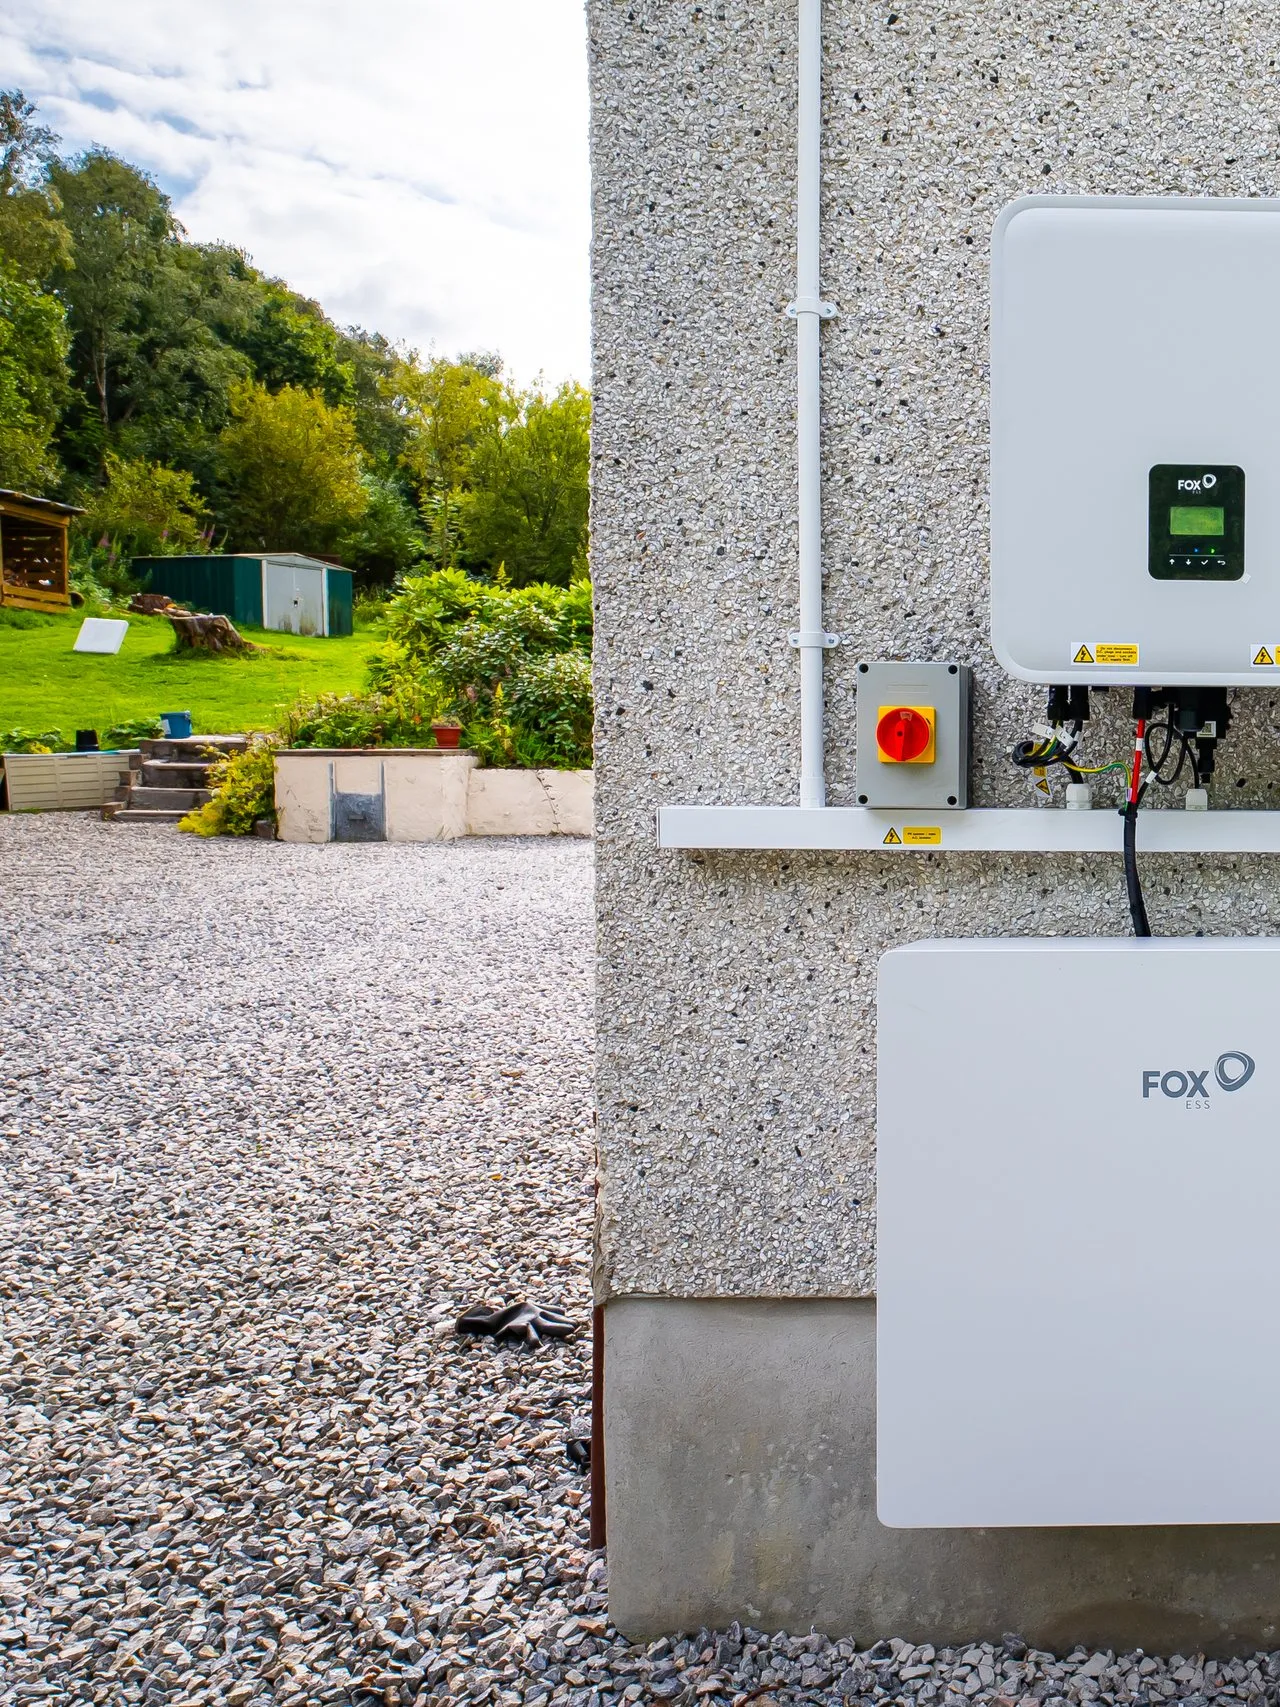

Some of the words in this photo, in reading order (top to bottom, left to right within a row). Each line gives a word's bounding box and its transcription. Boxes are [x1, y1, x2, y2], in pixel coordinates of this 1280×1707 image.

[1177, 480, 1201, 490] FOX
[1142, 1070, 1210, 1099] FOX
[1185, 1100, 1211, 1110] ESS
